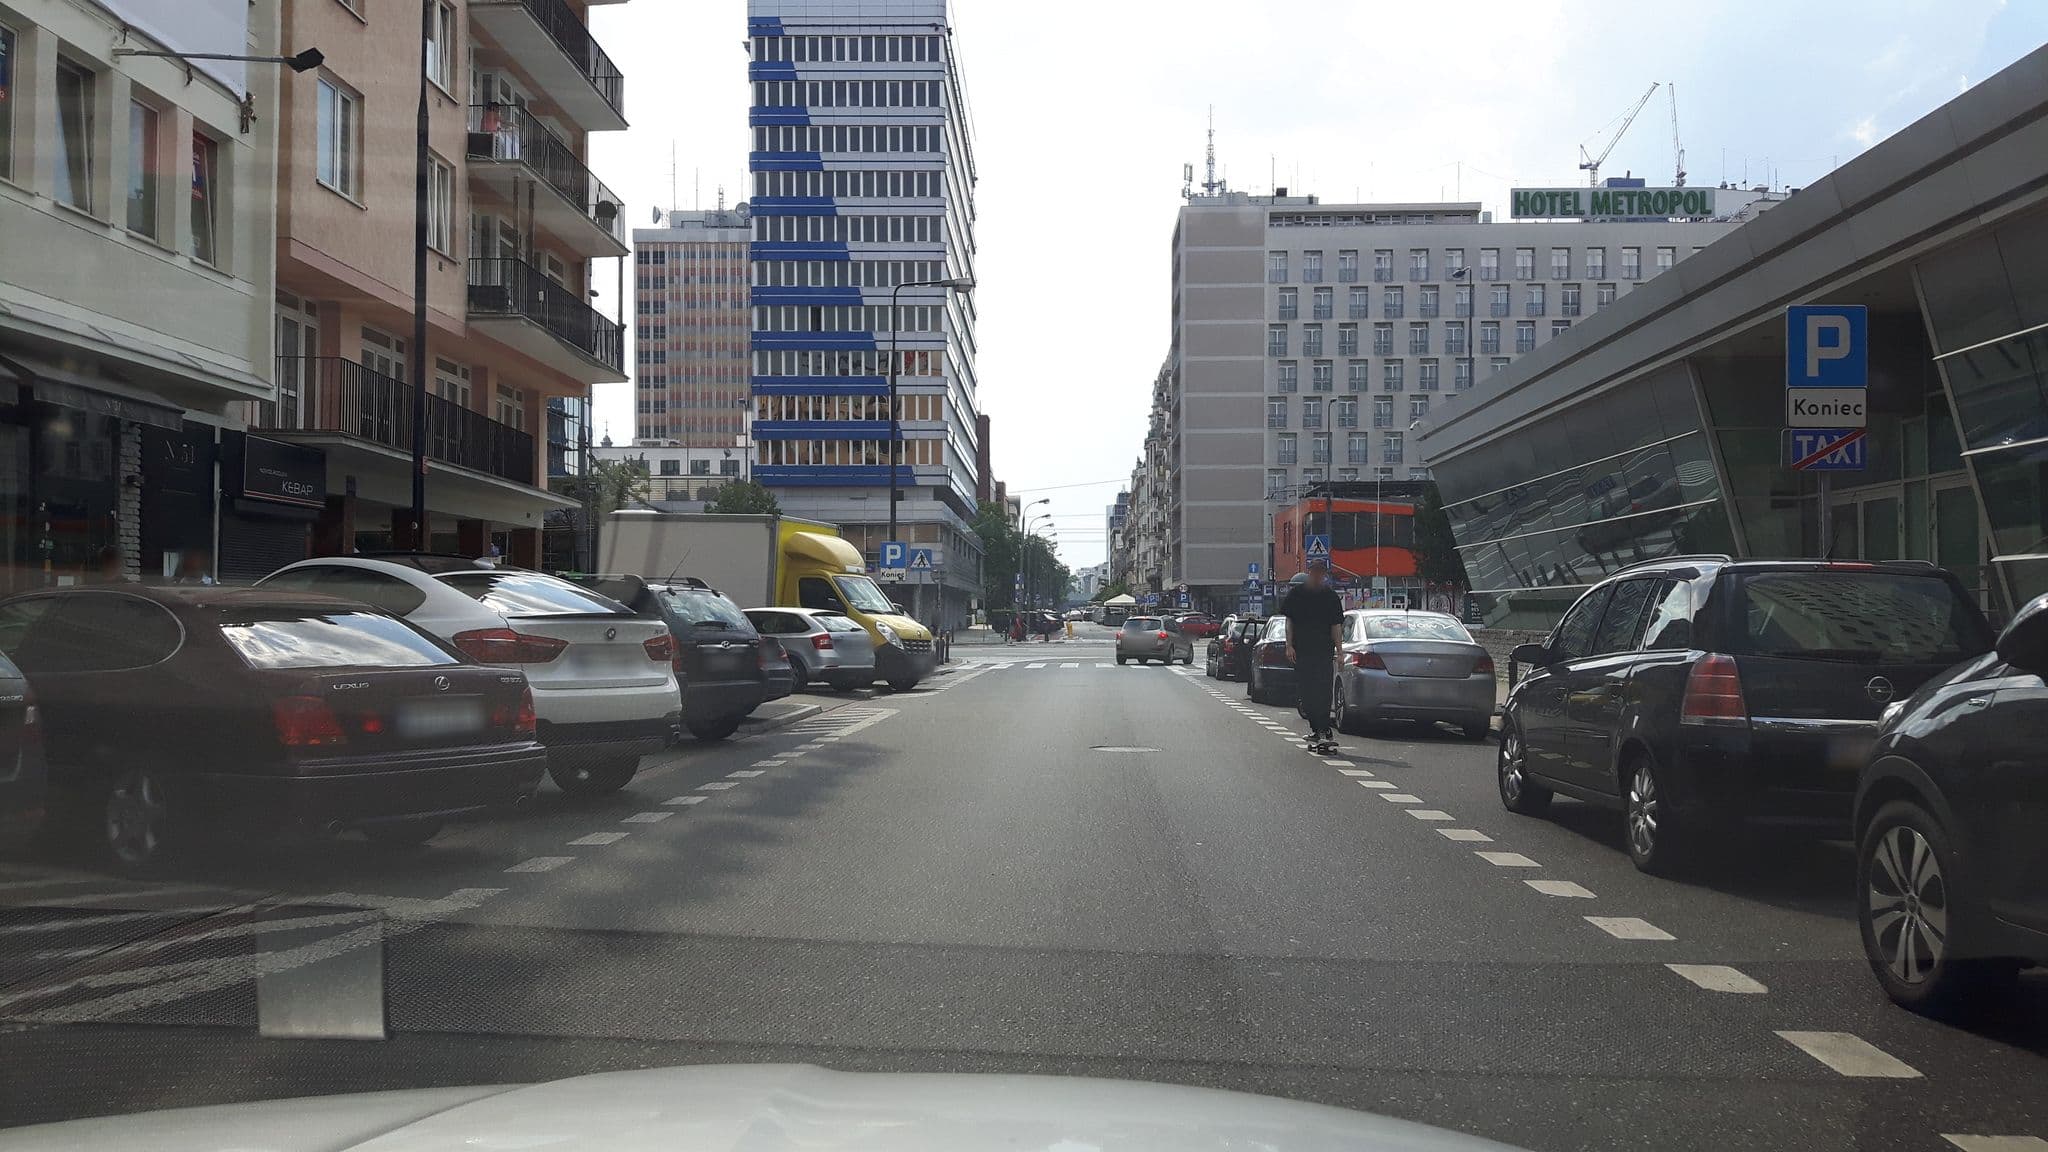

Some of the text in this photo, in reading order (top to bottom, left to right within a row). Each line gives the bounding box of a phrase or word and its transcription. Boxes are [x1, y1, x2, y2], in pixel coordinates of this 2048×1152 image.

[1514, 190, 1712, 216] HOTEL METROPOL
[1806, 315, 1851, 377] P
[1794, 398, 1863, 416] Koniec
[1796, 434, 1861, 465] TAXI
[282, 479, 313, 496] KEBAP
[886, 545, 901, 565] P
